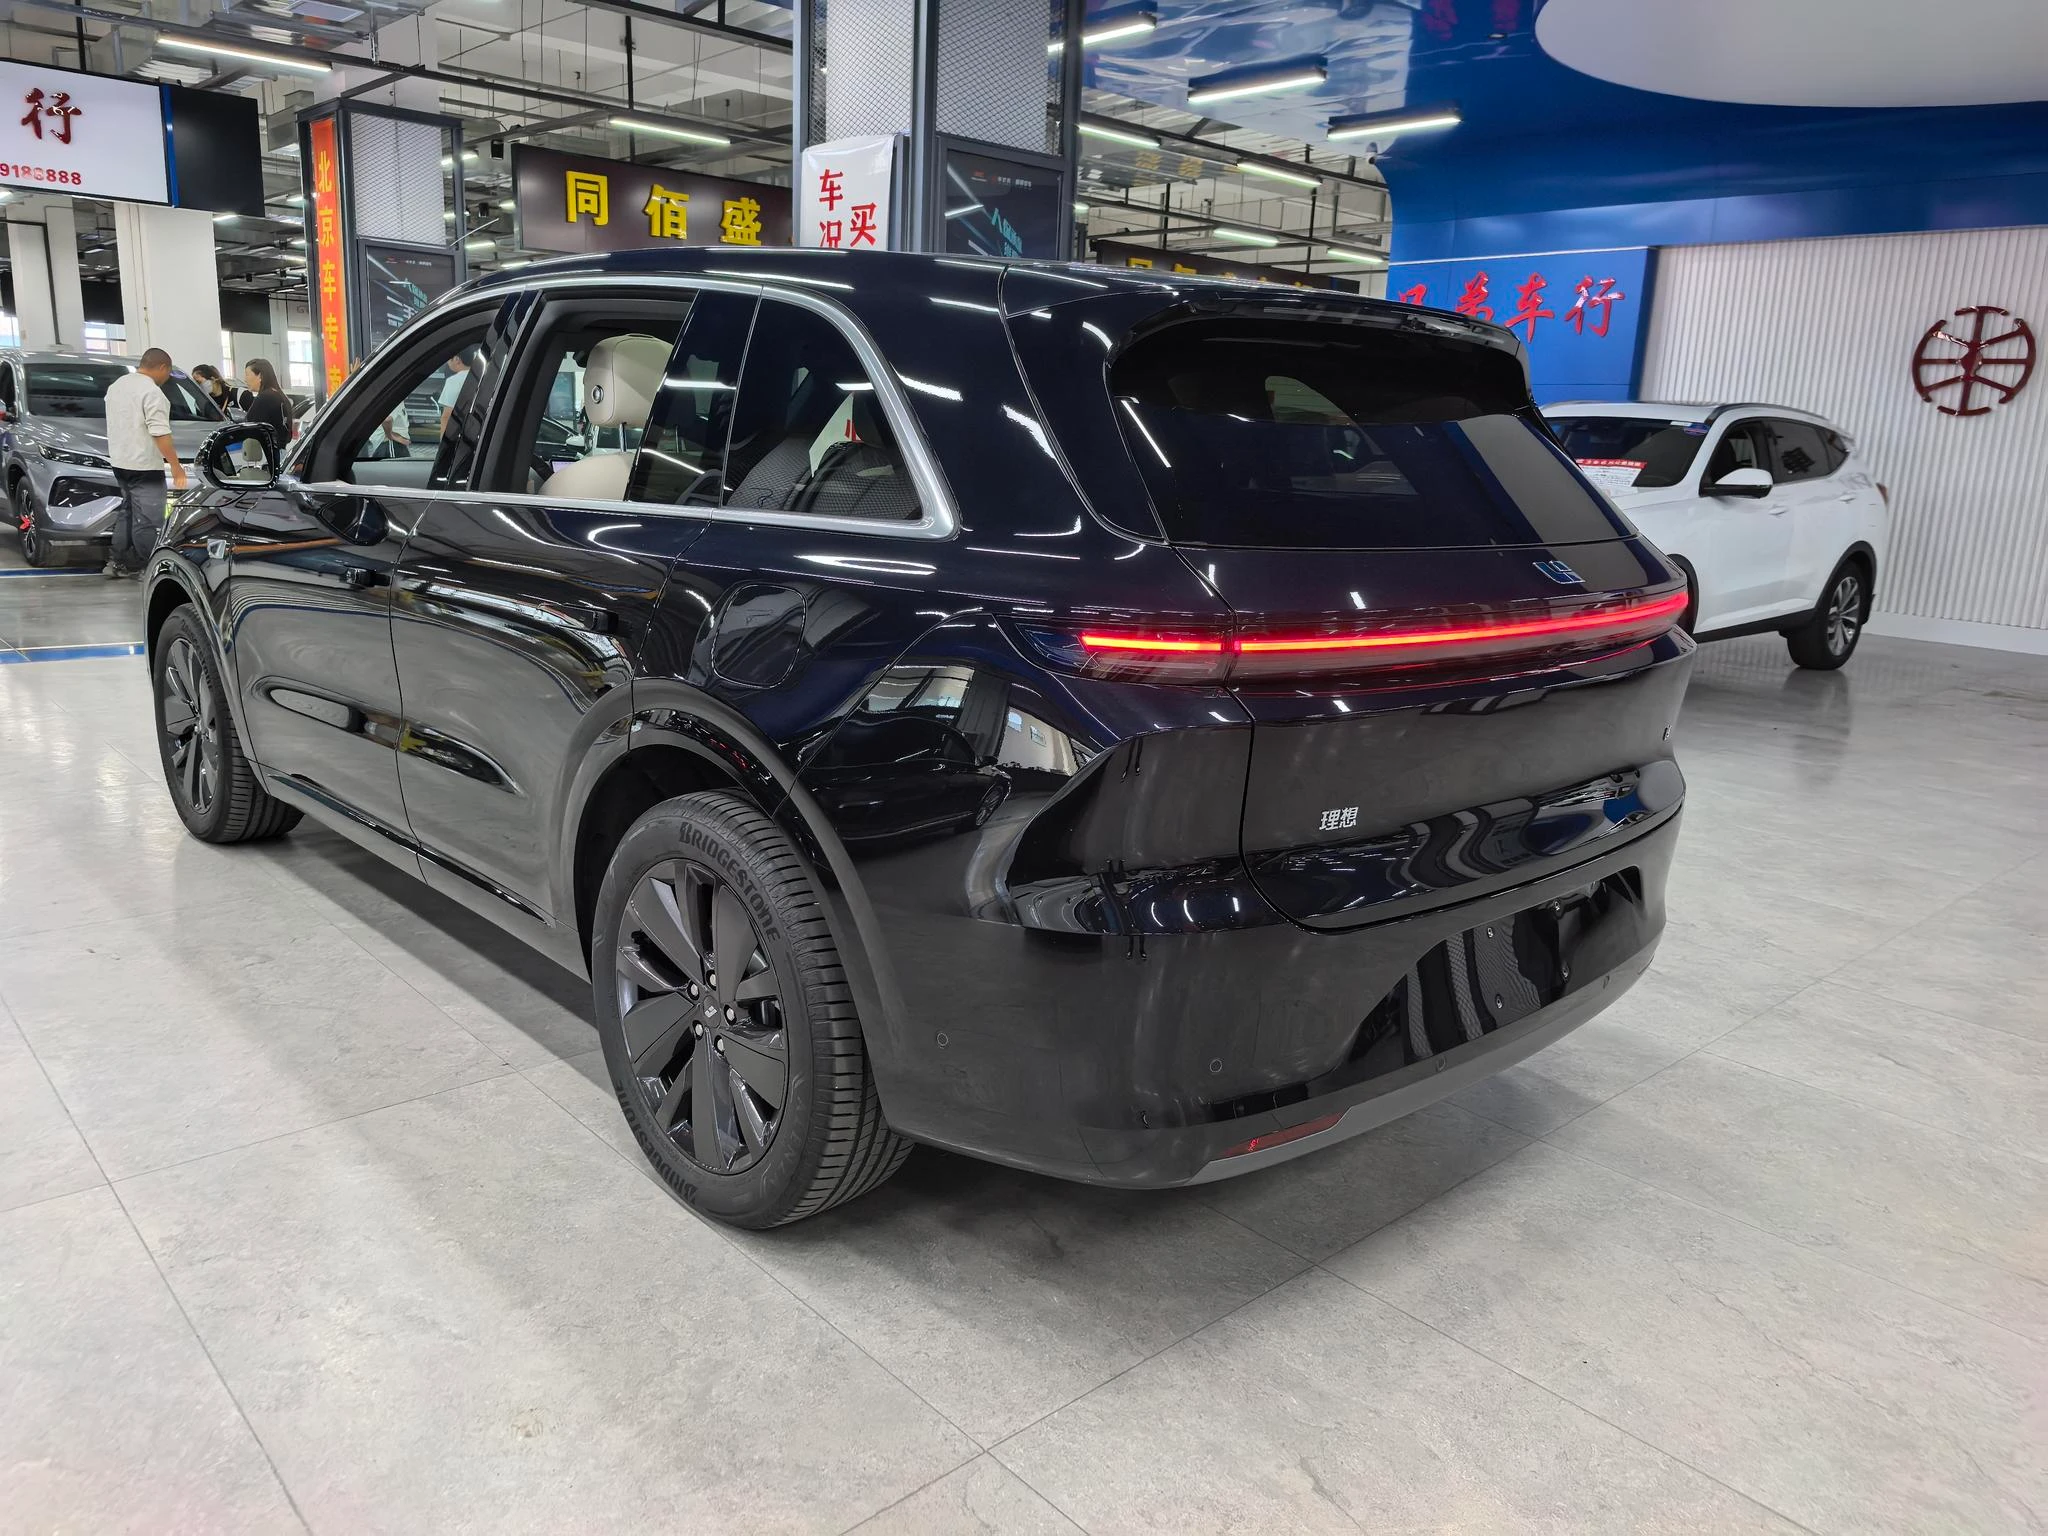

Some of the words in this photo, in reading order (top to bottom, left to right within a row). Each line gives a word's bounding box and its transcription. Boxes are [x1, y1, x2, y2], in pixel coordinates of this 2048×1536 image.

[21, 87, 82, 144] 行
[565, 170, 763, 247] 同佰盛
[1319, 806, 1359, 831] 理想
[679, 820, 781, 943] BRIDGESTONE
